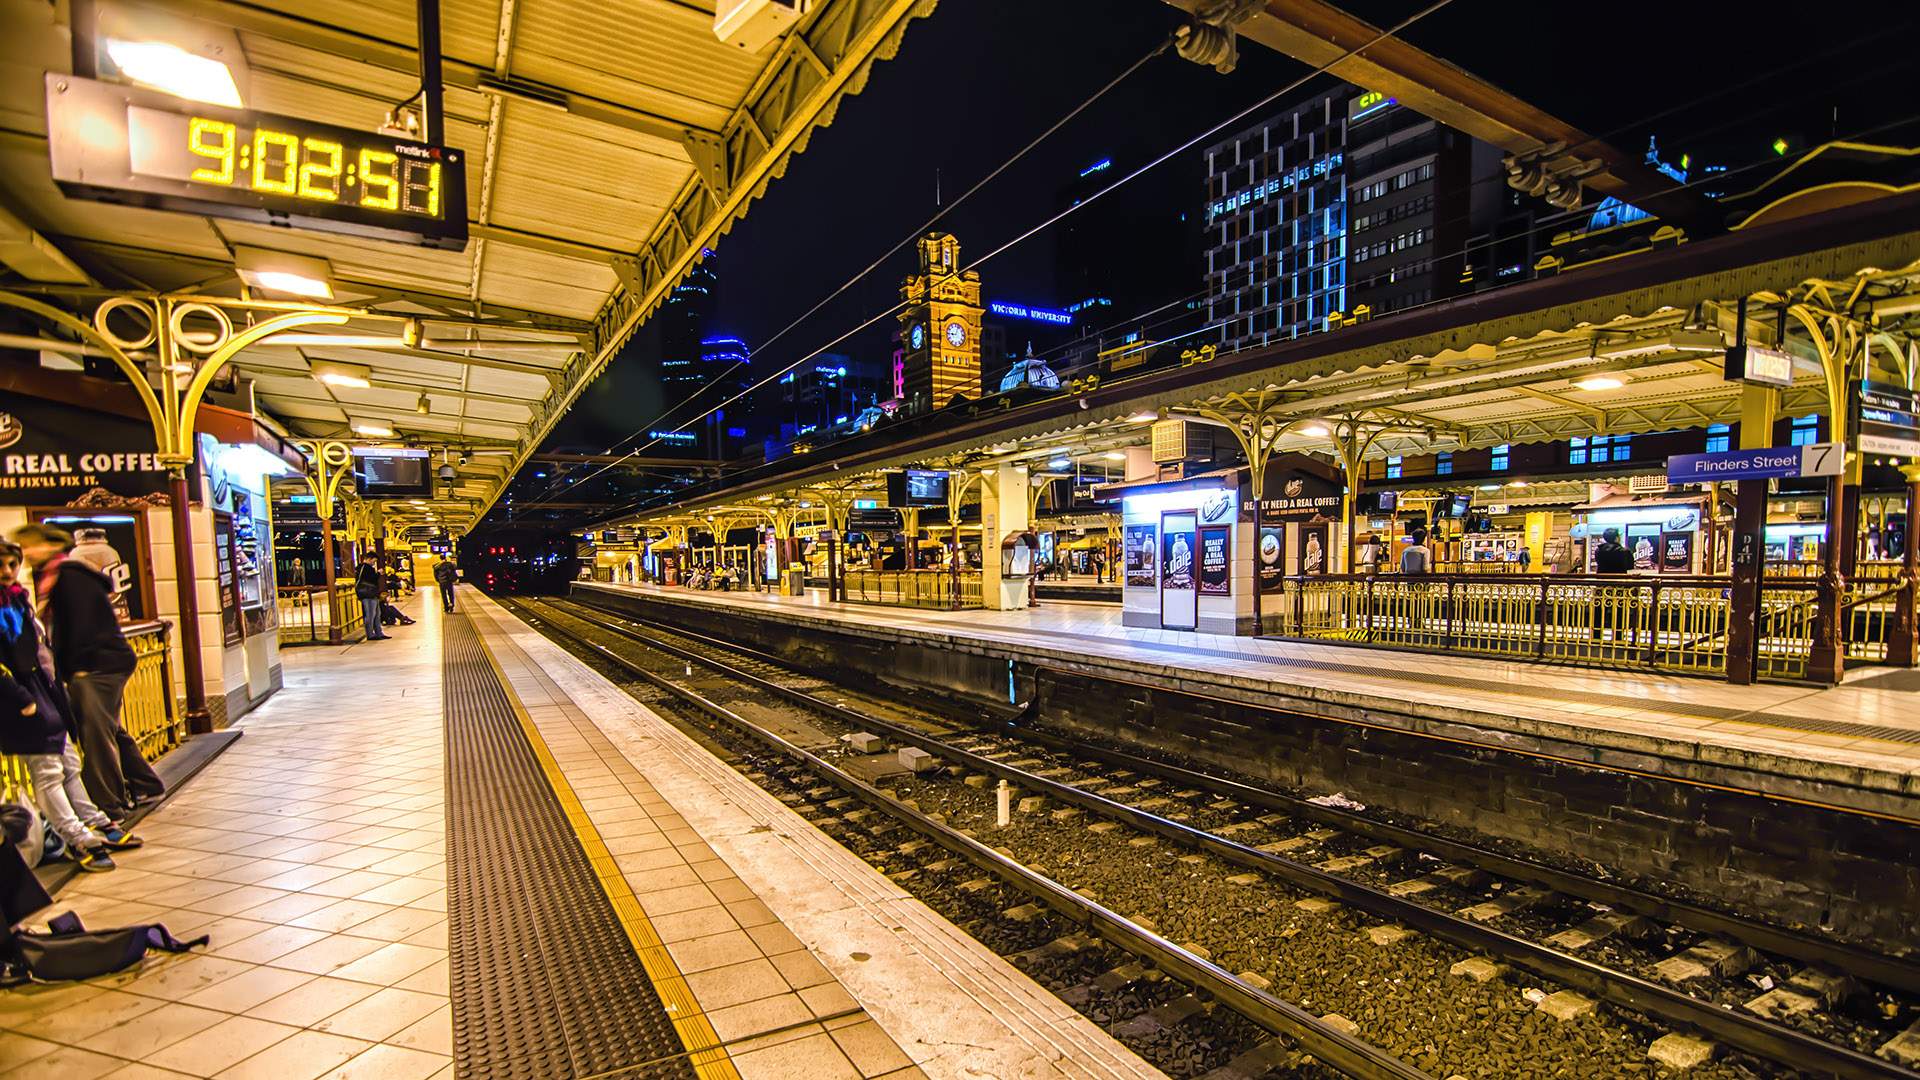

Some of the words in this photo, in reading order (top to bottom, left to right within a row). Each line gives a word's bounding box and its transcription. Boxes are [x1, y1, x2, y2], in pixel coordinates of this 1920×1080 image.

[188, 116, 441, 217] 9:02:51
[992, 303, 1027, 317] VICTORIA
[1031, 310, 1071, 324] UNIVERSITY
[6, 454, 72, 474] REAL
[1695, 459, 1749, 472] Flinders
[1753, 455, 1797, 469] Street
[1811, 446, 1832, 473] 7
[60, 476, 80, 486] FIX
[1243, 500, 1269, 511] RELY
[1270, 500, 1289, 509] NEED
[1289, 500, 1296, 508] A
[1296, 498, 1313, 507] REAL
[1205, 538, 1224, 546] REALLY
[1170, 551, 1192, 574] dare
[1304, 549, 1322, 570] dare
[1633, 546, 1654, 561] dare
